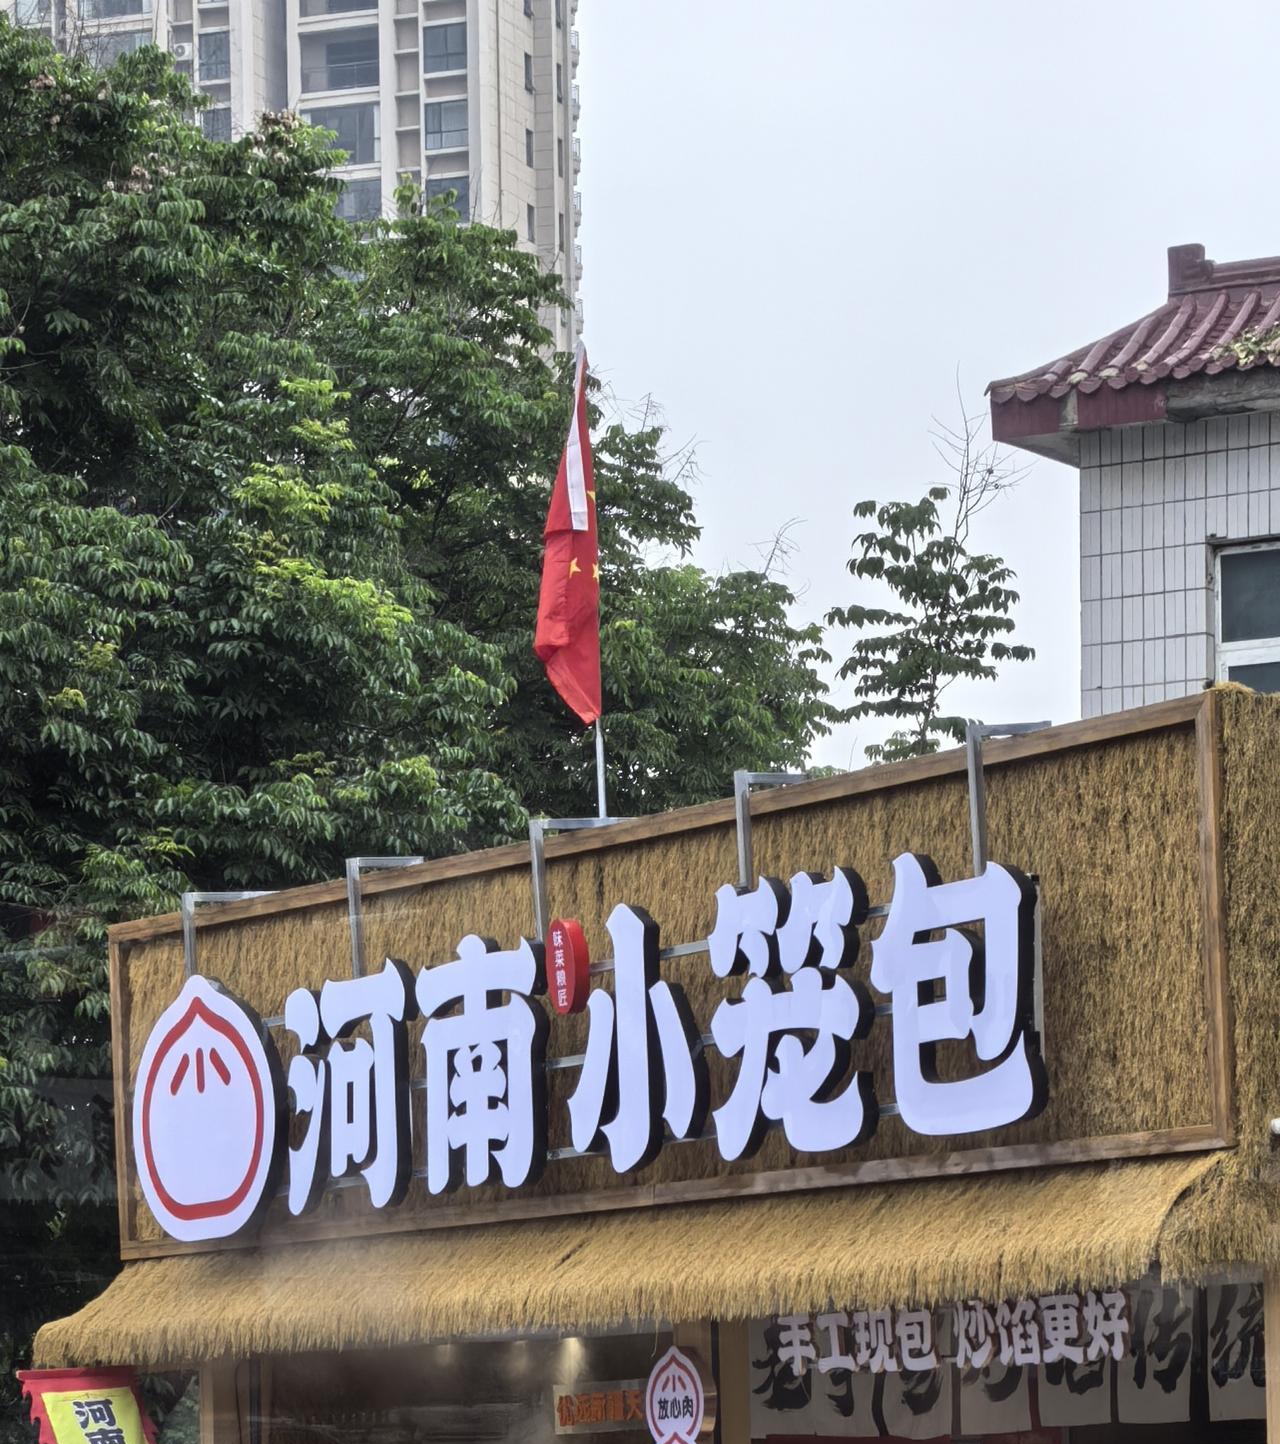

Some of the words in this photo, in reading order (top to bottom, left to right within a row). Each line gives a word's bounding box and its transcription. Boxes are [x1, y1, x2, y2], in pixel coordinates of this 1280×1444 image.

[285, 852, 1034, 1216] 河南小笼包
[776, 1309, 938, 1376] 手工现包
[954, 1291, 1129, 1369] 炒馅更好
[657, 1395, 694, 1420] 放心肉
